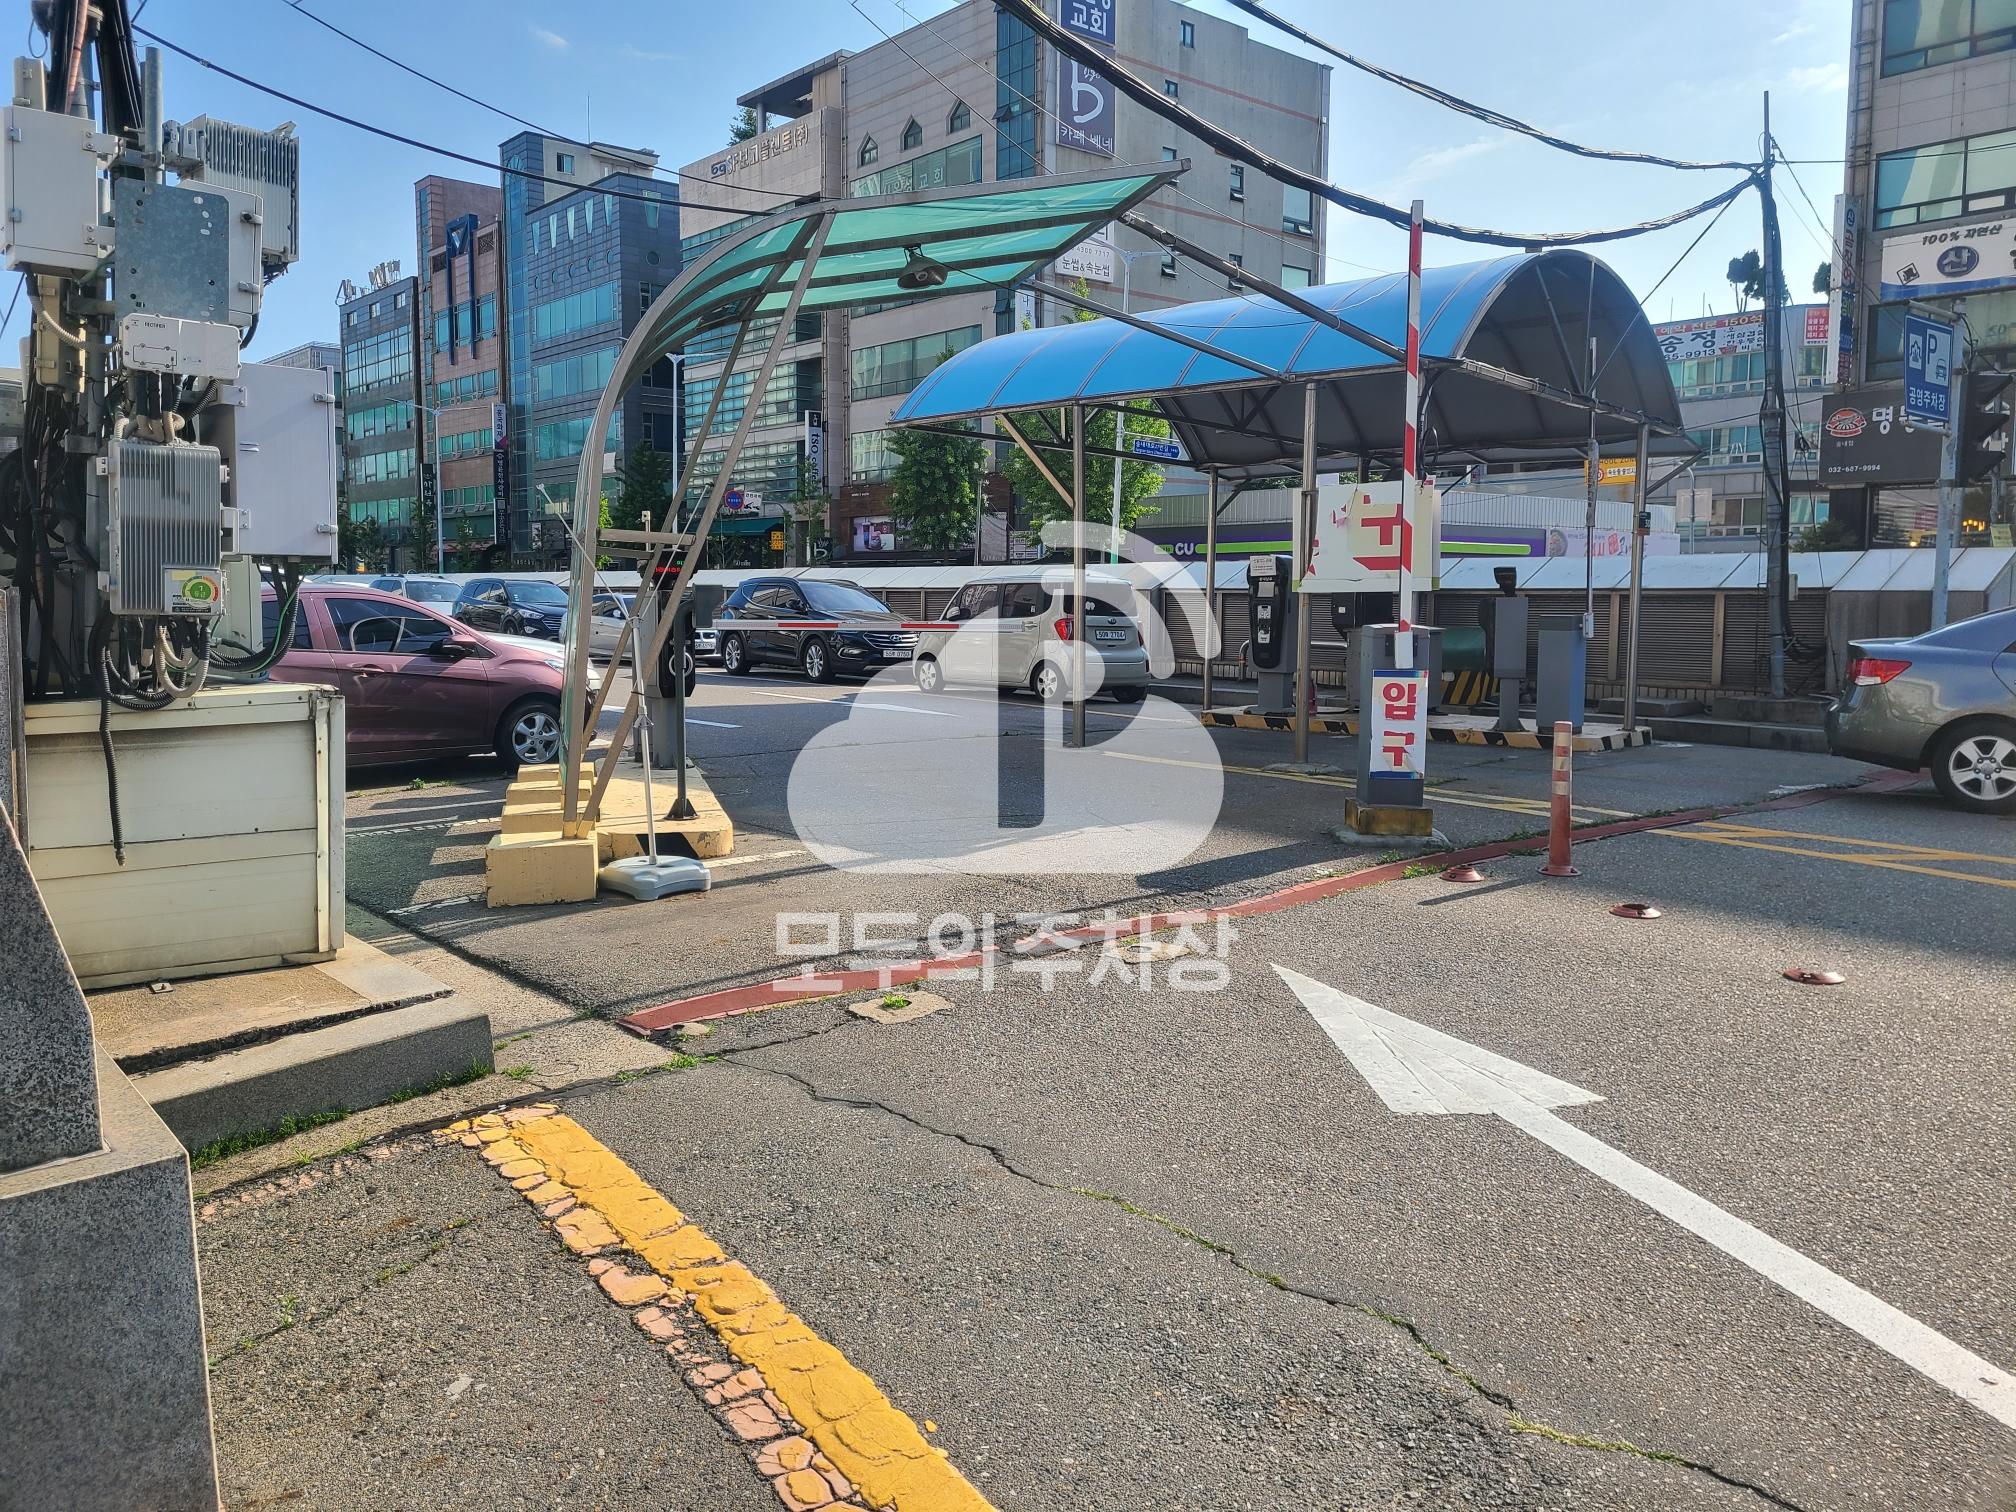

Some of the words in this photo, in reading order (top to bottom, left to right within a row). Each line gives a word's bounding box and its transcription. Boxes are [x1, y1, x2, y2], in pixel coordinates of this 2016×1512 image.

[1070, 2, 1107, 36] 교회
[1922, 230, 1961, 246] 100%
[1964, 223, 2003, 239] 자연산
[1909, 386, 1946, 412] 공영주차장
[1175, 542, 1194, 556] CU
